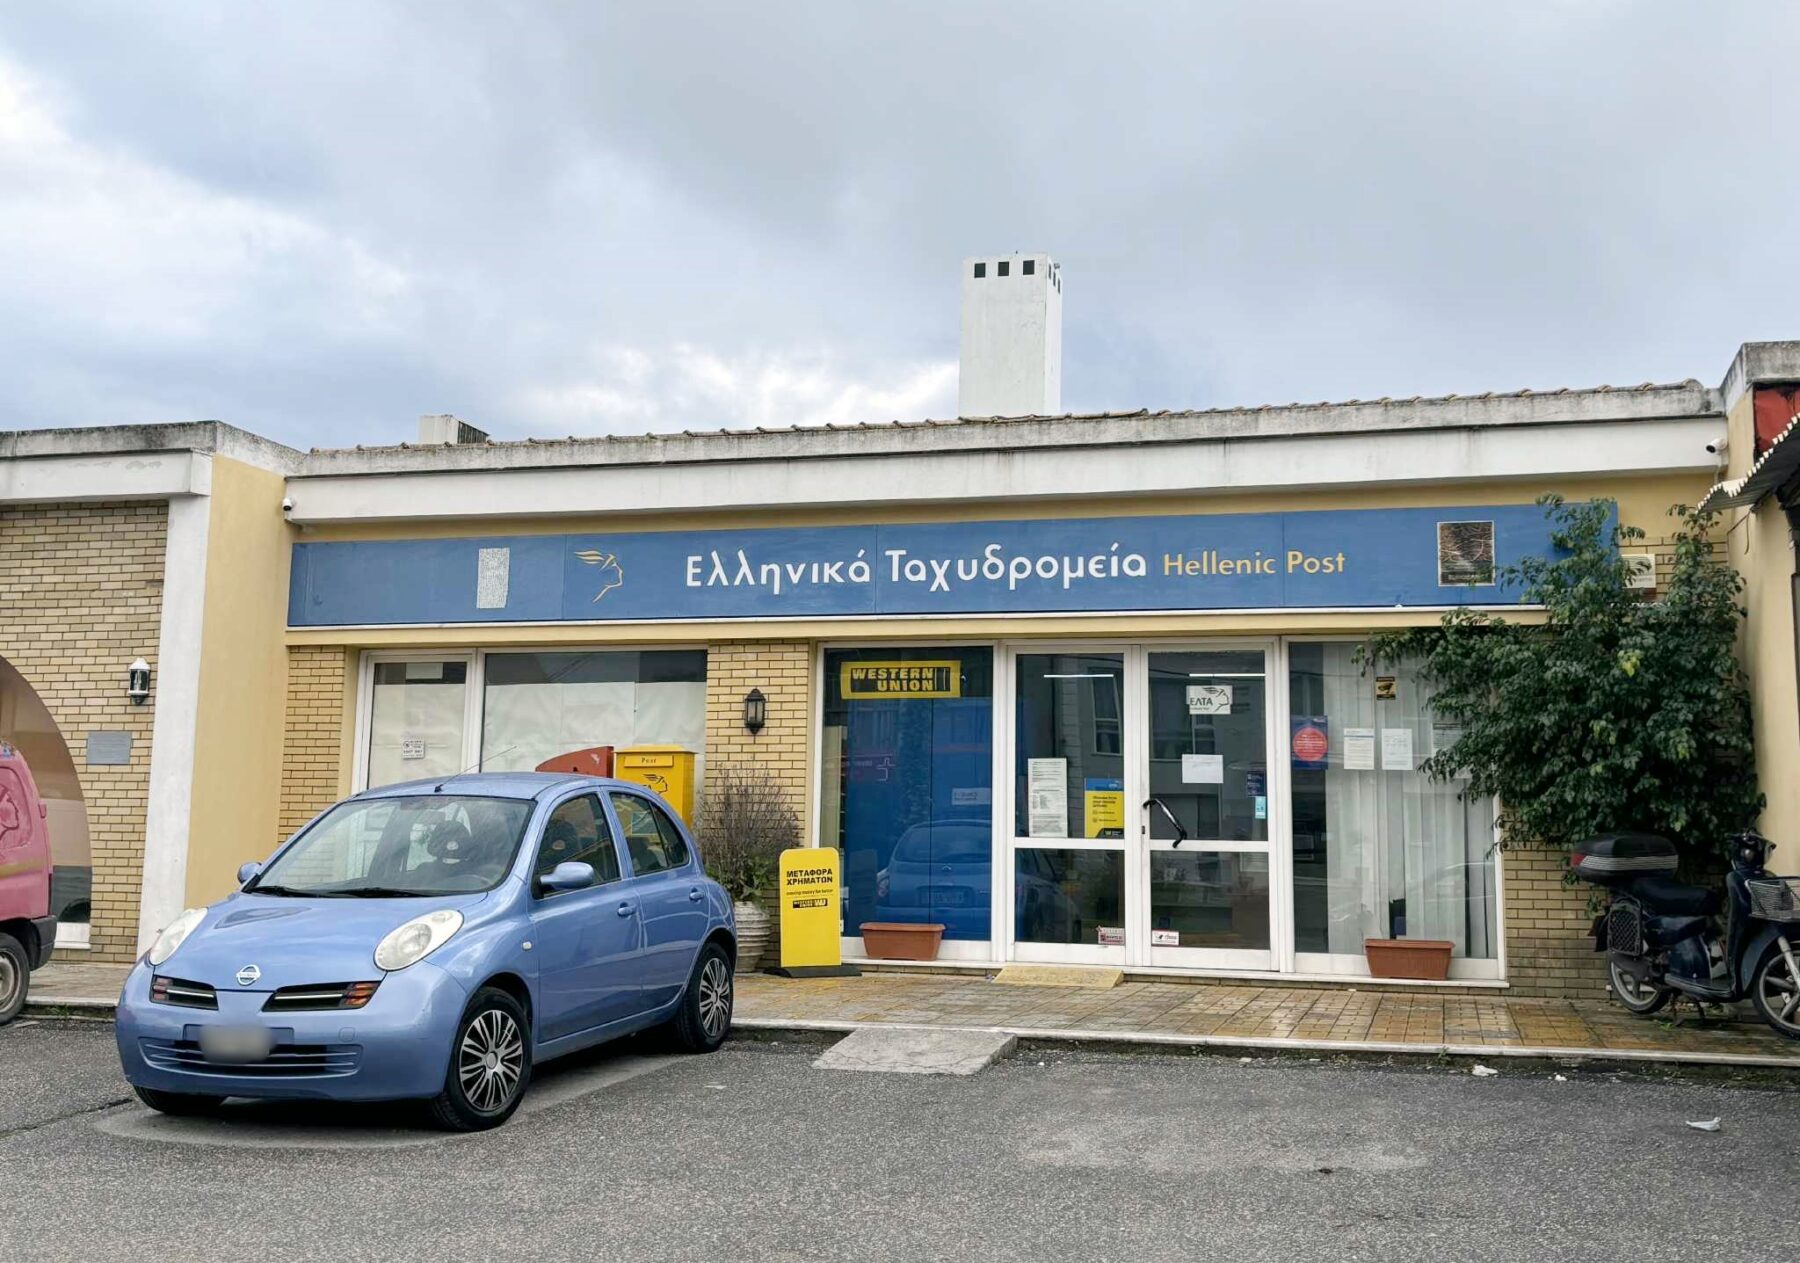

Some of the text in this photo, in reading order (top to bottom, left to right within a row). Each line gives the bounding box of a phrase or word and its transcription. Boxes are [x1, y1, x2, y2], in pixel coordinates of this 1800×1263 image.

[686, 542, 1147, 595] Ελληνικά Ταχυδρομεία
[1163, 550, 1346, 576] Hellenic Post
[852, 667, 933, 680] WESTERN
[877, 679, 933, 692] UNION
[1190, 697, 1213, 706] ΕΛΤΑ
[786, 868, 833, 878] ΜΕΤΑΦΟΡΑ
[786, 876, 833, 886] ΧΡΗΜΑΤΩΝ
